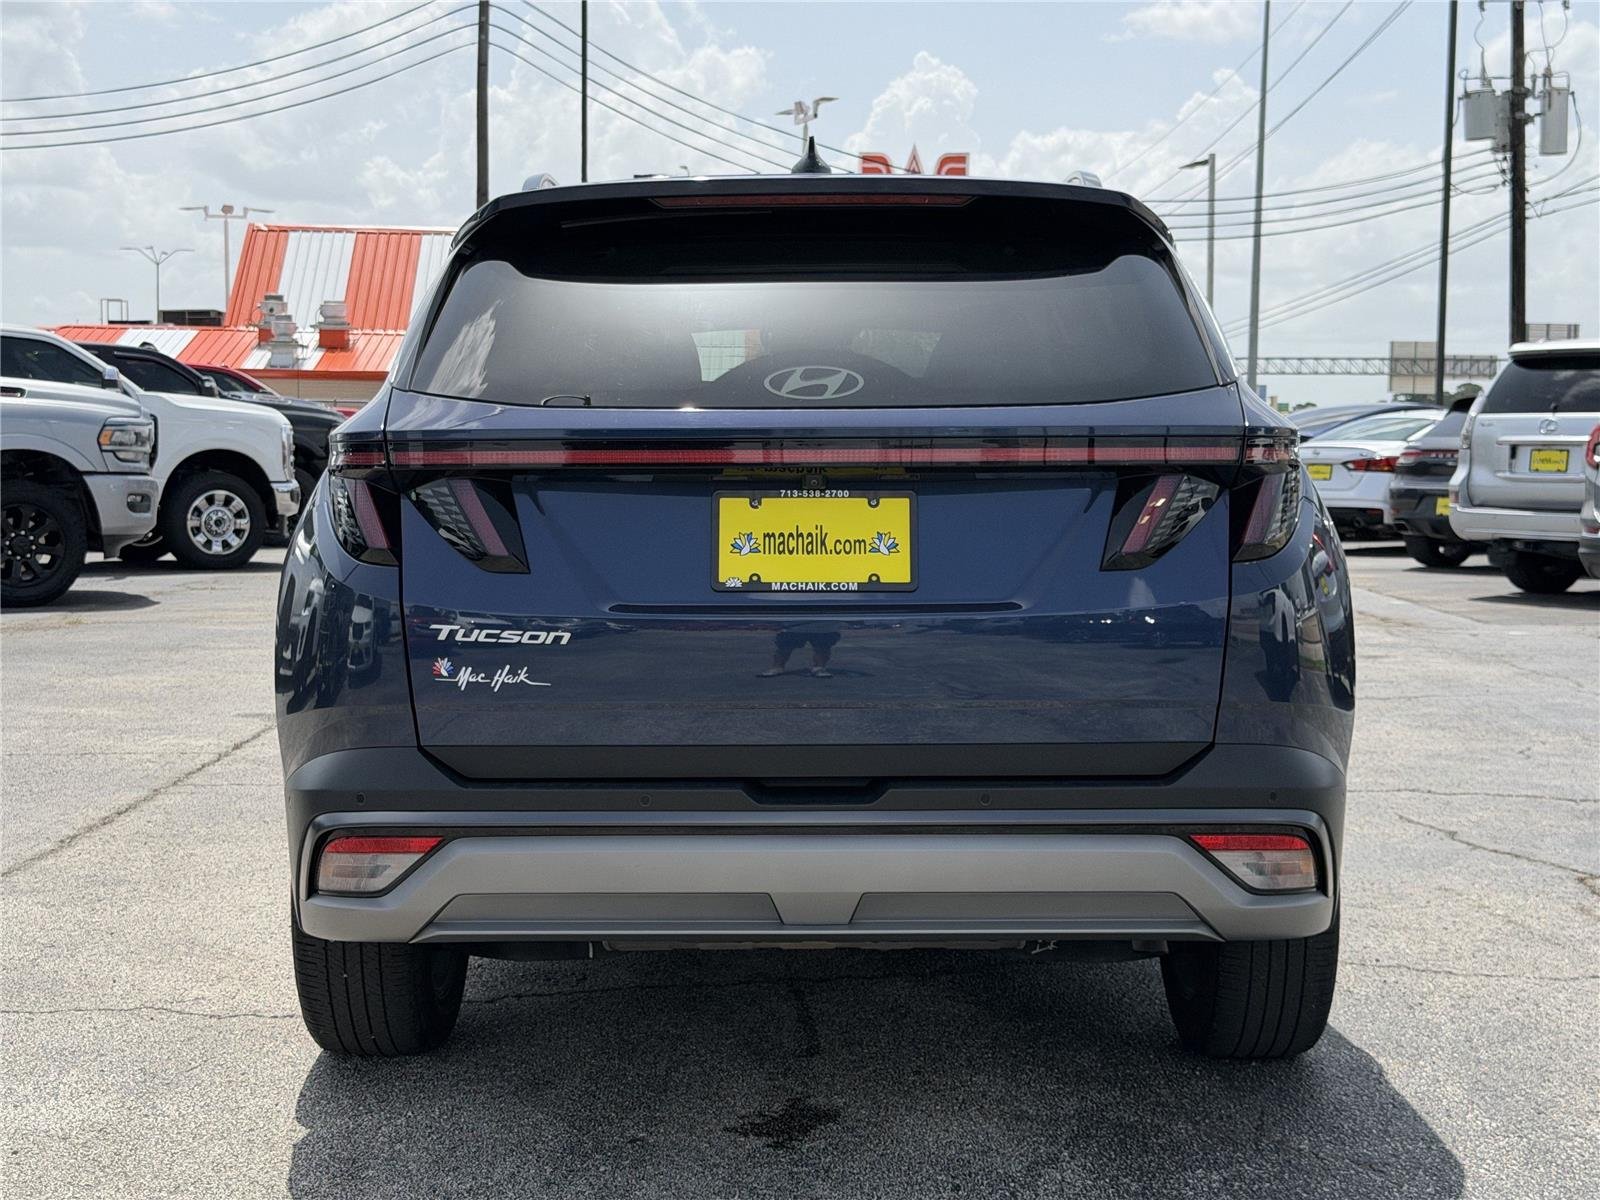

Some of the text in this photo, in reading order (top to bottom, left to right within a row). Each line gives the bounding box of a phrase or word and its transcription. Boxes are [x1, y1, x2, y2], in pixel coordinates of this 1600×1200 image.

[779, 489, 850, 498] 713-538-2700
[762, 524, 867, 555] machaik.com
[771, 582, 859, 591] MACHAIK.COM
[455, 664, 551, 692] Mac Haik
